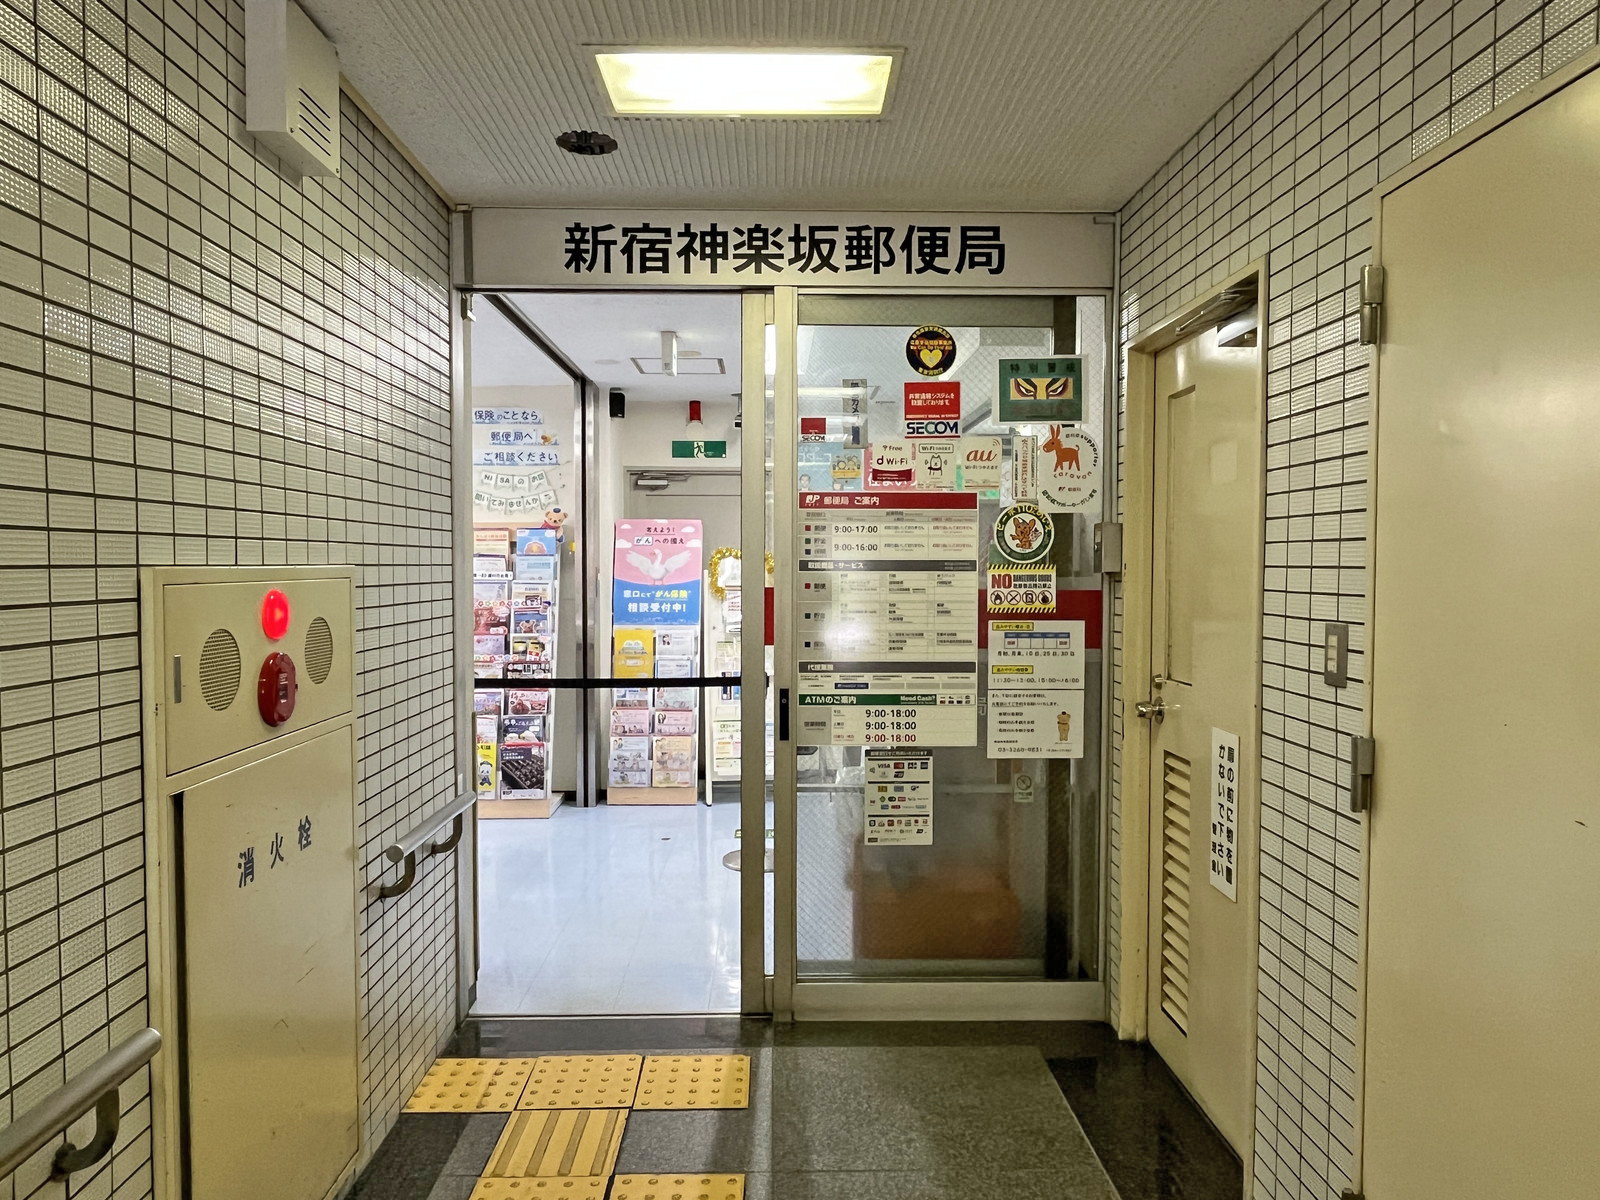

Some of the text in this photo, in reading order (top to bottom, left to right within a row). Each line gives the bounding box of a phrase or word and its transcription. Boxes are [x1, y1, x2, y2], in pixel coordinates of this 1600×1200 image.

[563, 221, 1007, 275] 新宿神楽坂郵便局
[474, 410, 539, 421] 保険のことなら
[906, 420, 959, 435] SECOM
[490, 431, 533, 442] 郵便局へ
[801, 434, 826, 442] SECOM
[483, 451, 559, 463] ご相談ください
[876, 455, 908, 466] d Wi-Fi
[966, 449, 998, 462] au
[823, 496, 850, 505] 郵便局
[854, 496, 880, 505] ご案内
[834, 525, 879, 534] 9:00-17:00
[635, 537, 685, 545] がんへの備え
[834, 543, 879, 552] 9:00-16:00
[991, 573, 1013, 589] NO
[627, 602, 687, 613] 相談受付中!
[804, 695, 857, 705] ATMのご案内
[865, 709, 918, 718] 9:00-18:00
[865, 721, 918, 730] 9:00-18:00
[865, 733, 918, 743] 9:00-18:00
[1216, 743, 1226, 877] かないで下さい
[237, 814, 313, 889] 消火栓
